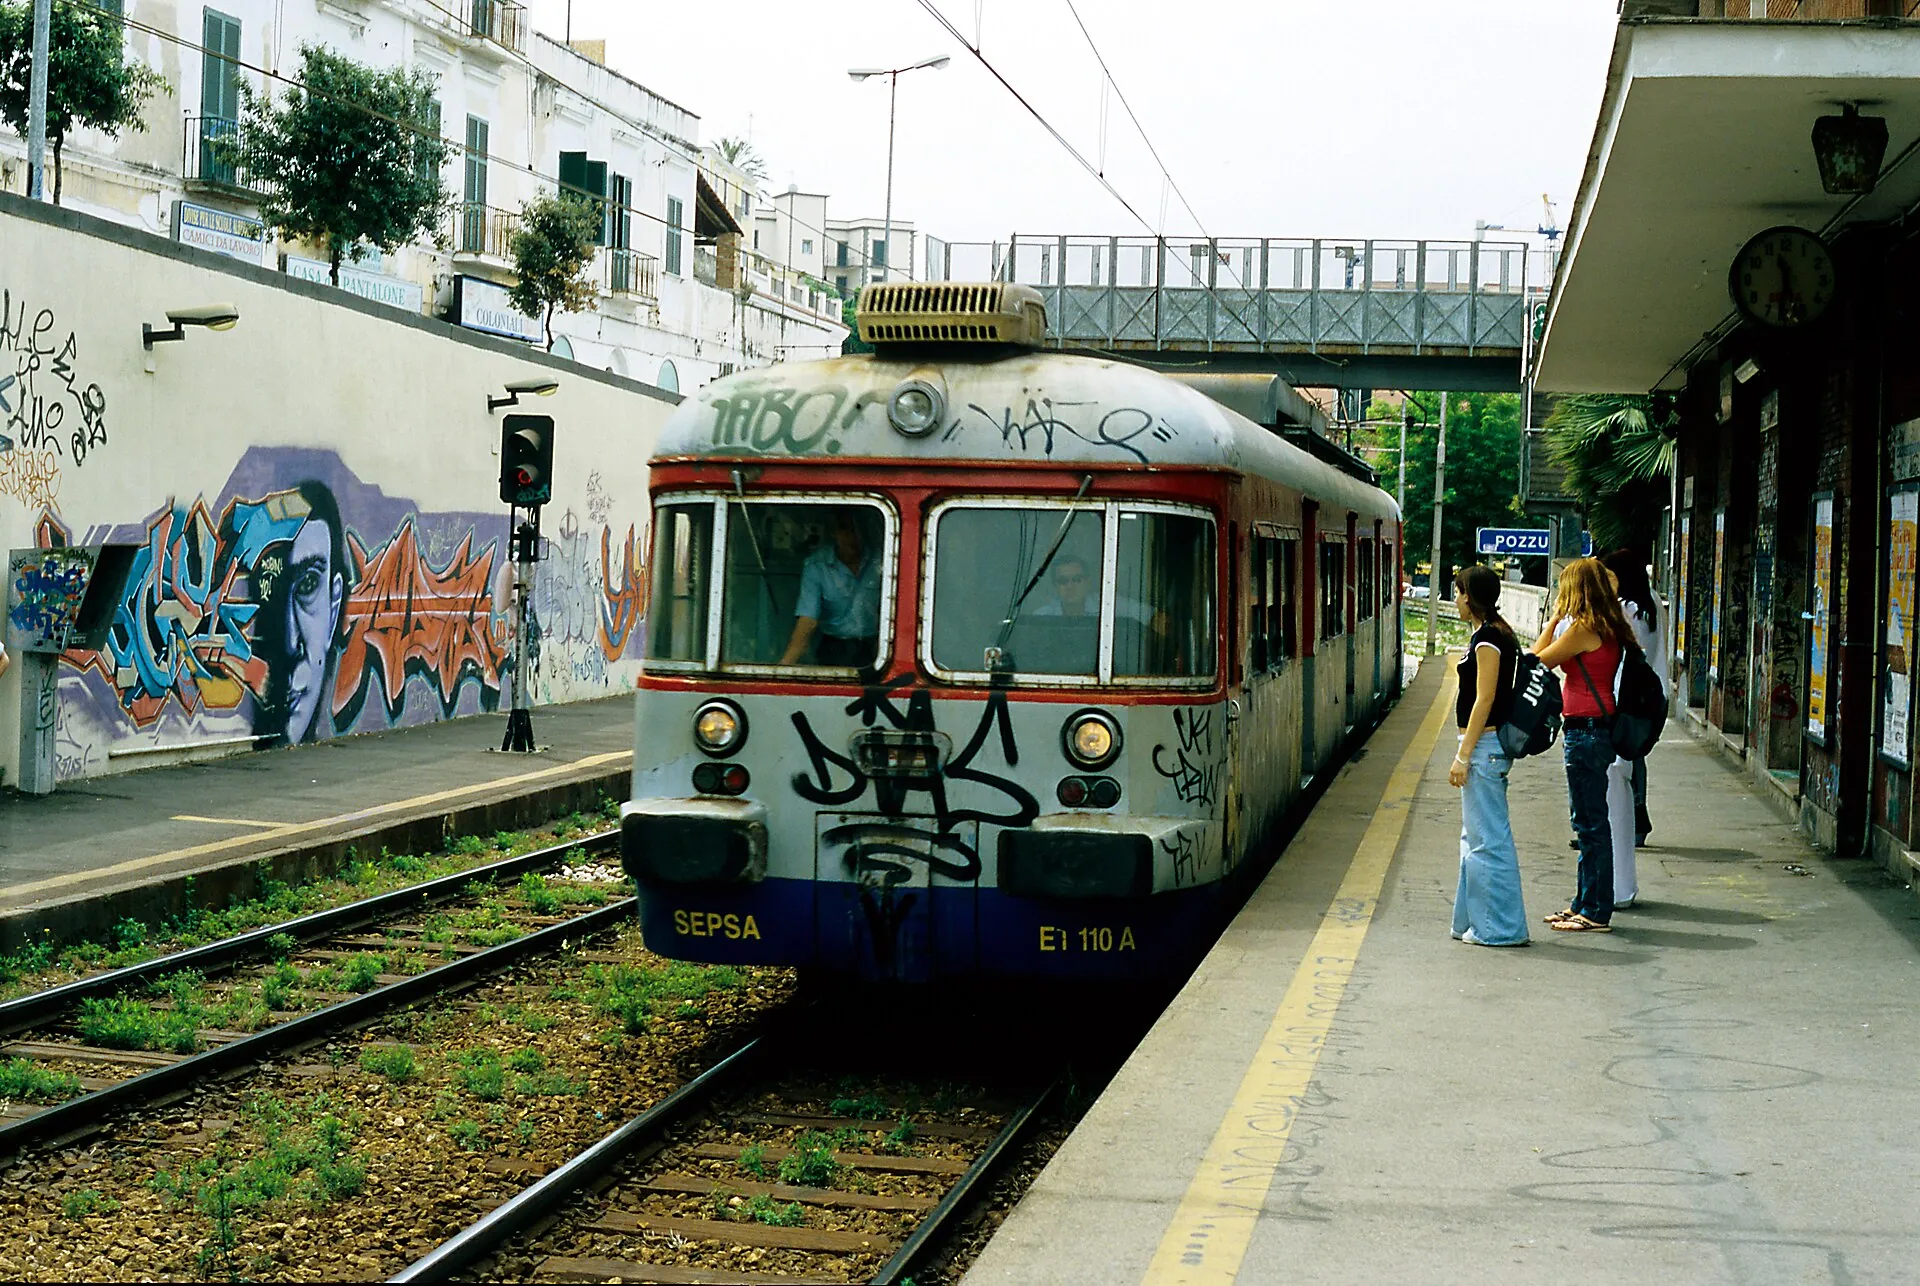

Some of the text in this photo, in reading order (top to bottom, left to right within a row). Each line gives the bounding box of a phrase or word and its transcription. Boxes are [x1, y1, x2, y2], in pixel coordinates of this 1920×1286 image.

[183, 228, 214, 247] CAMICI
[215, 236, 228, 250] DA
[229, 239, 260, 257] LAVORO
[293, 264, 321, 284] CASA
[343, 275, 406, 305] PANTALONE
[476, 307, 524, 334] COLONIALI
[1495, 535, 1549, 549] POZZU
[674, 909, 761, 941] SEPSA
[1078, 927, 1113, 952] 110
[1119, 926, 1136, 951] A
